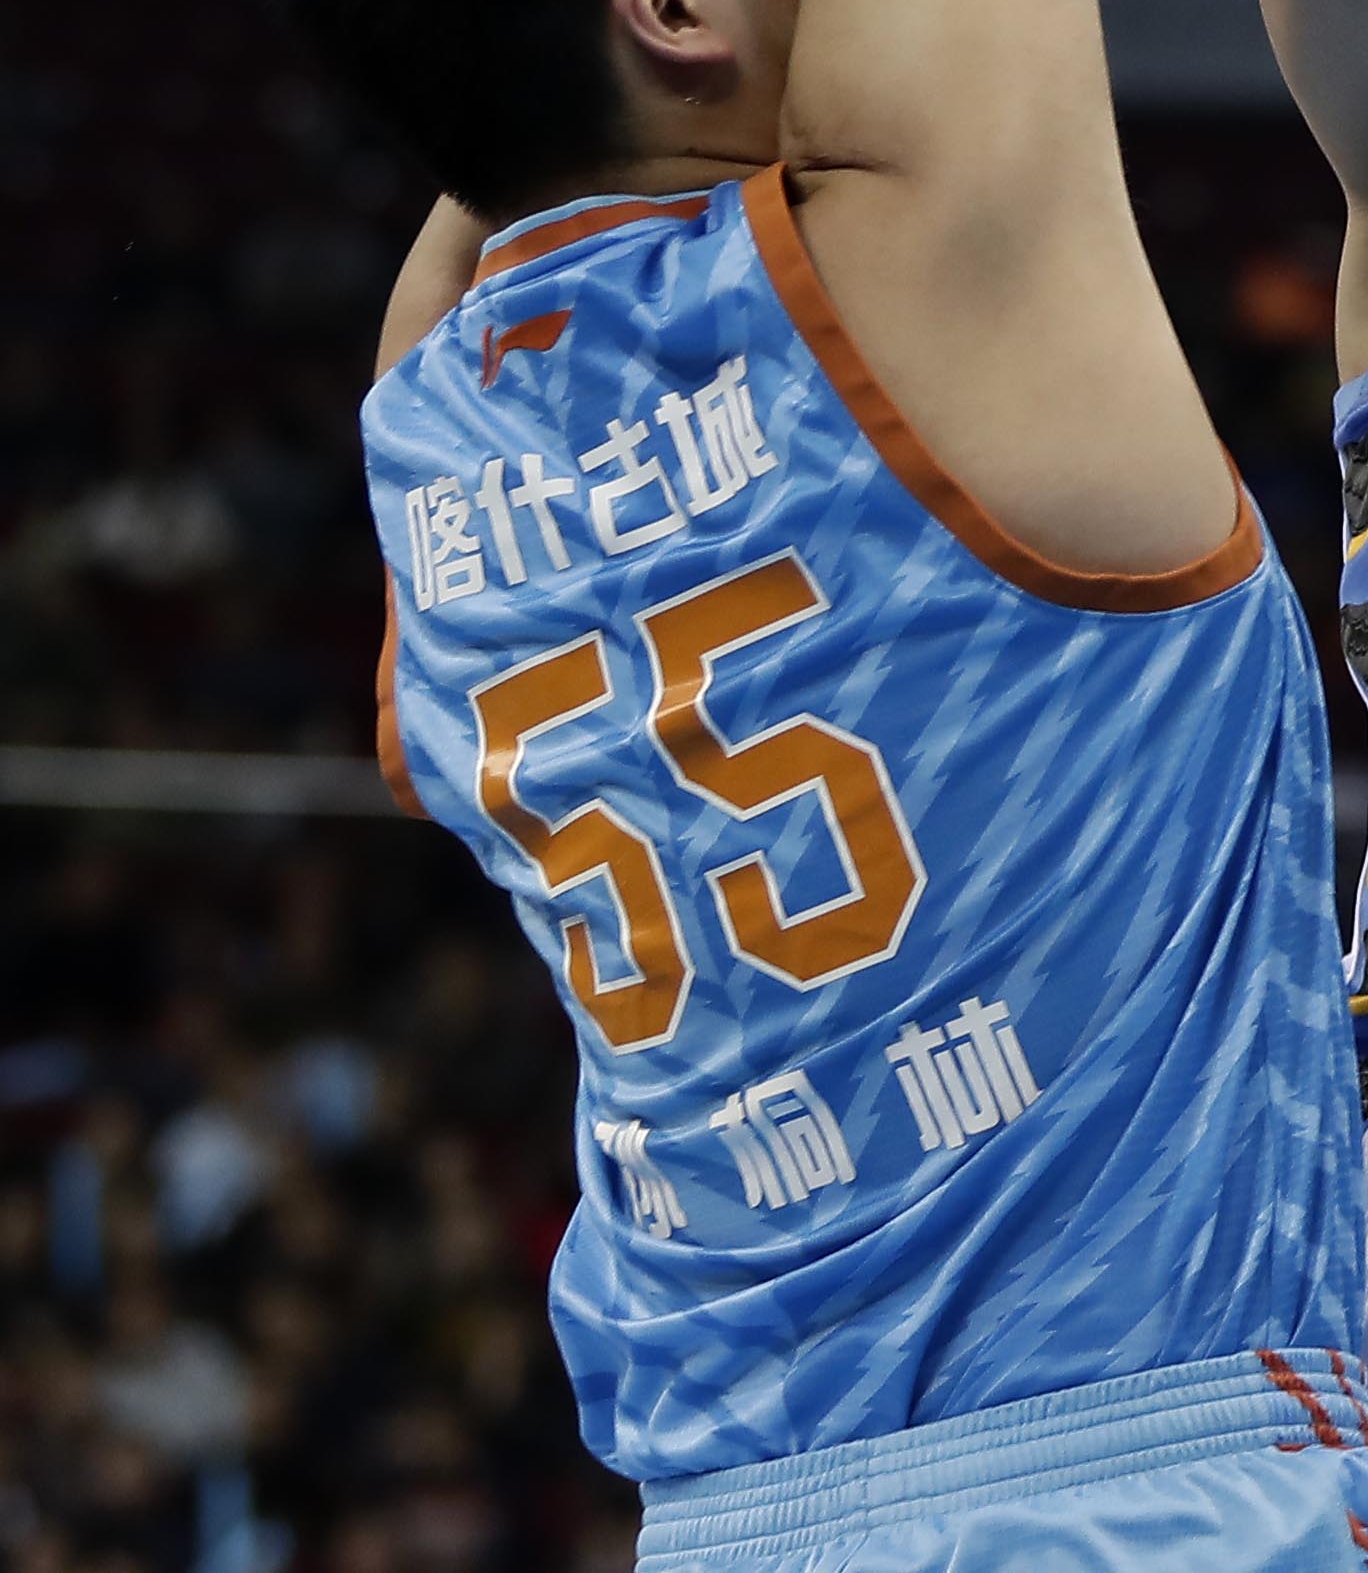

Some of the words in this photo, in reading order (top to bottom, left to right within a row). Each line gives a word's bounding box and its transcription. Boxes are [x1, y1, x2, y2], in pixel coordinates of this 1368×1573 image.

[405, 355, 779, 612] 喀什古城
[468, 547, 928, 1056] 55
